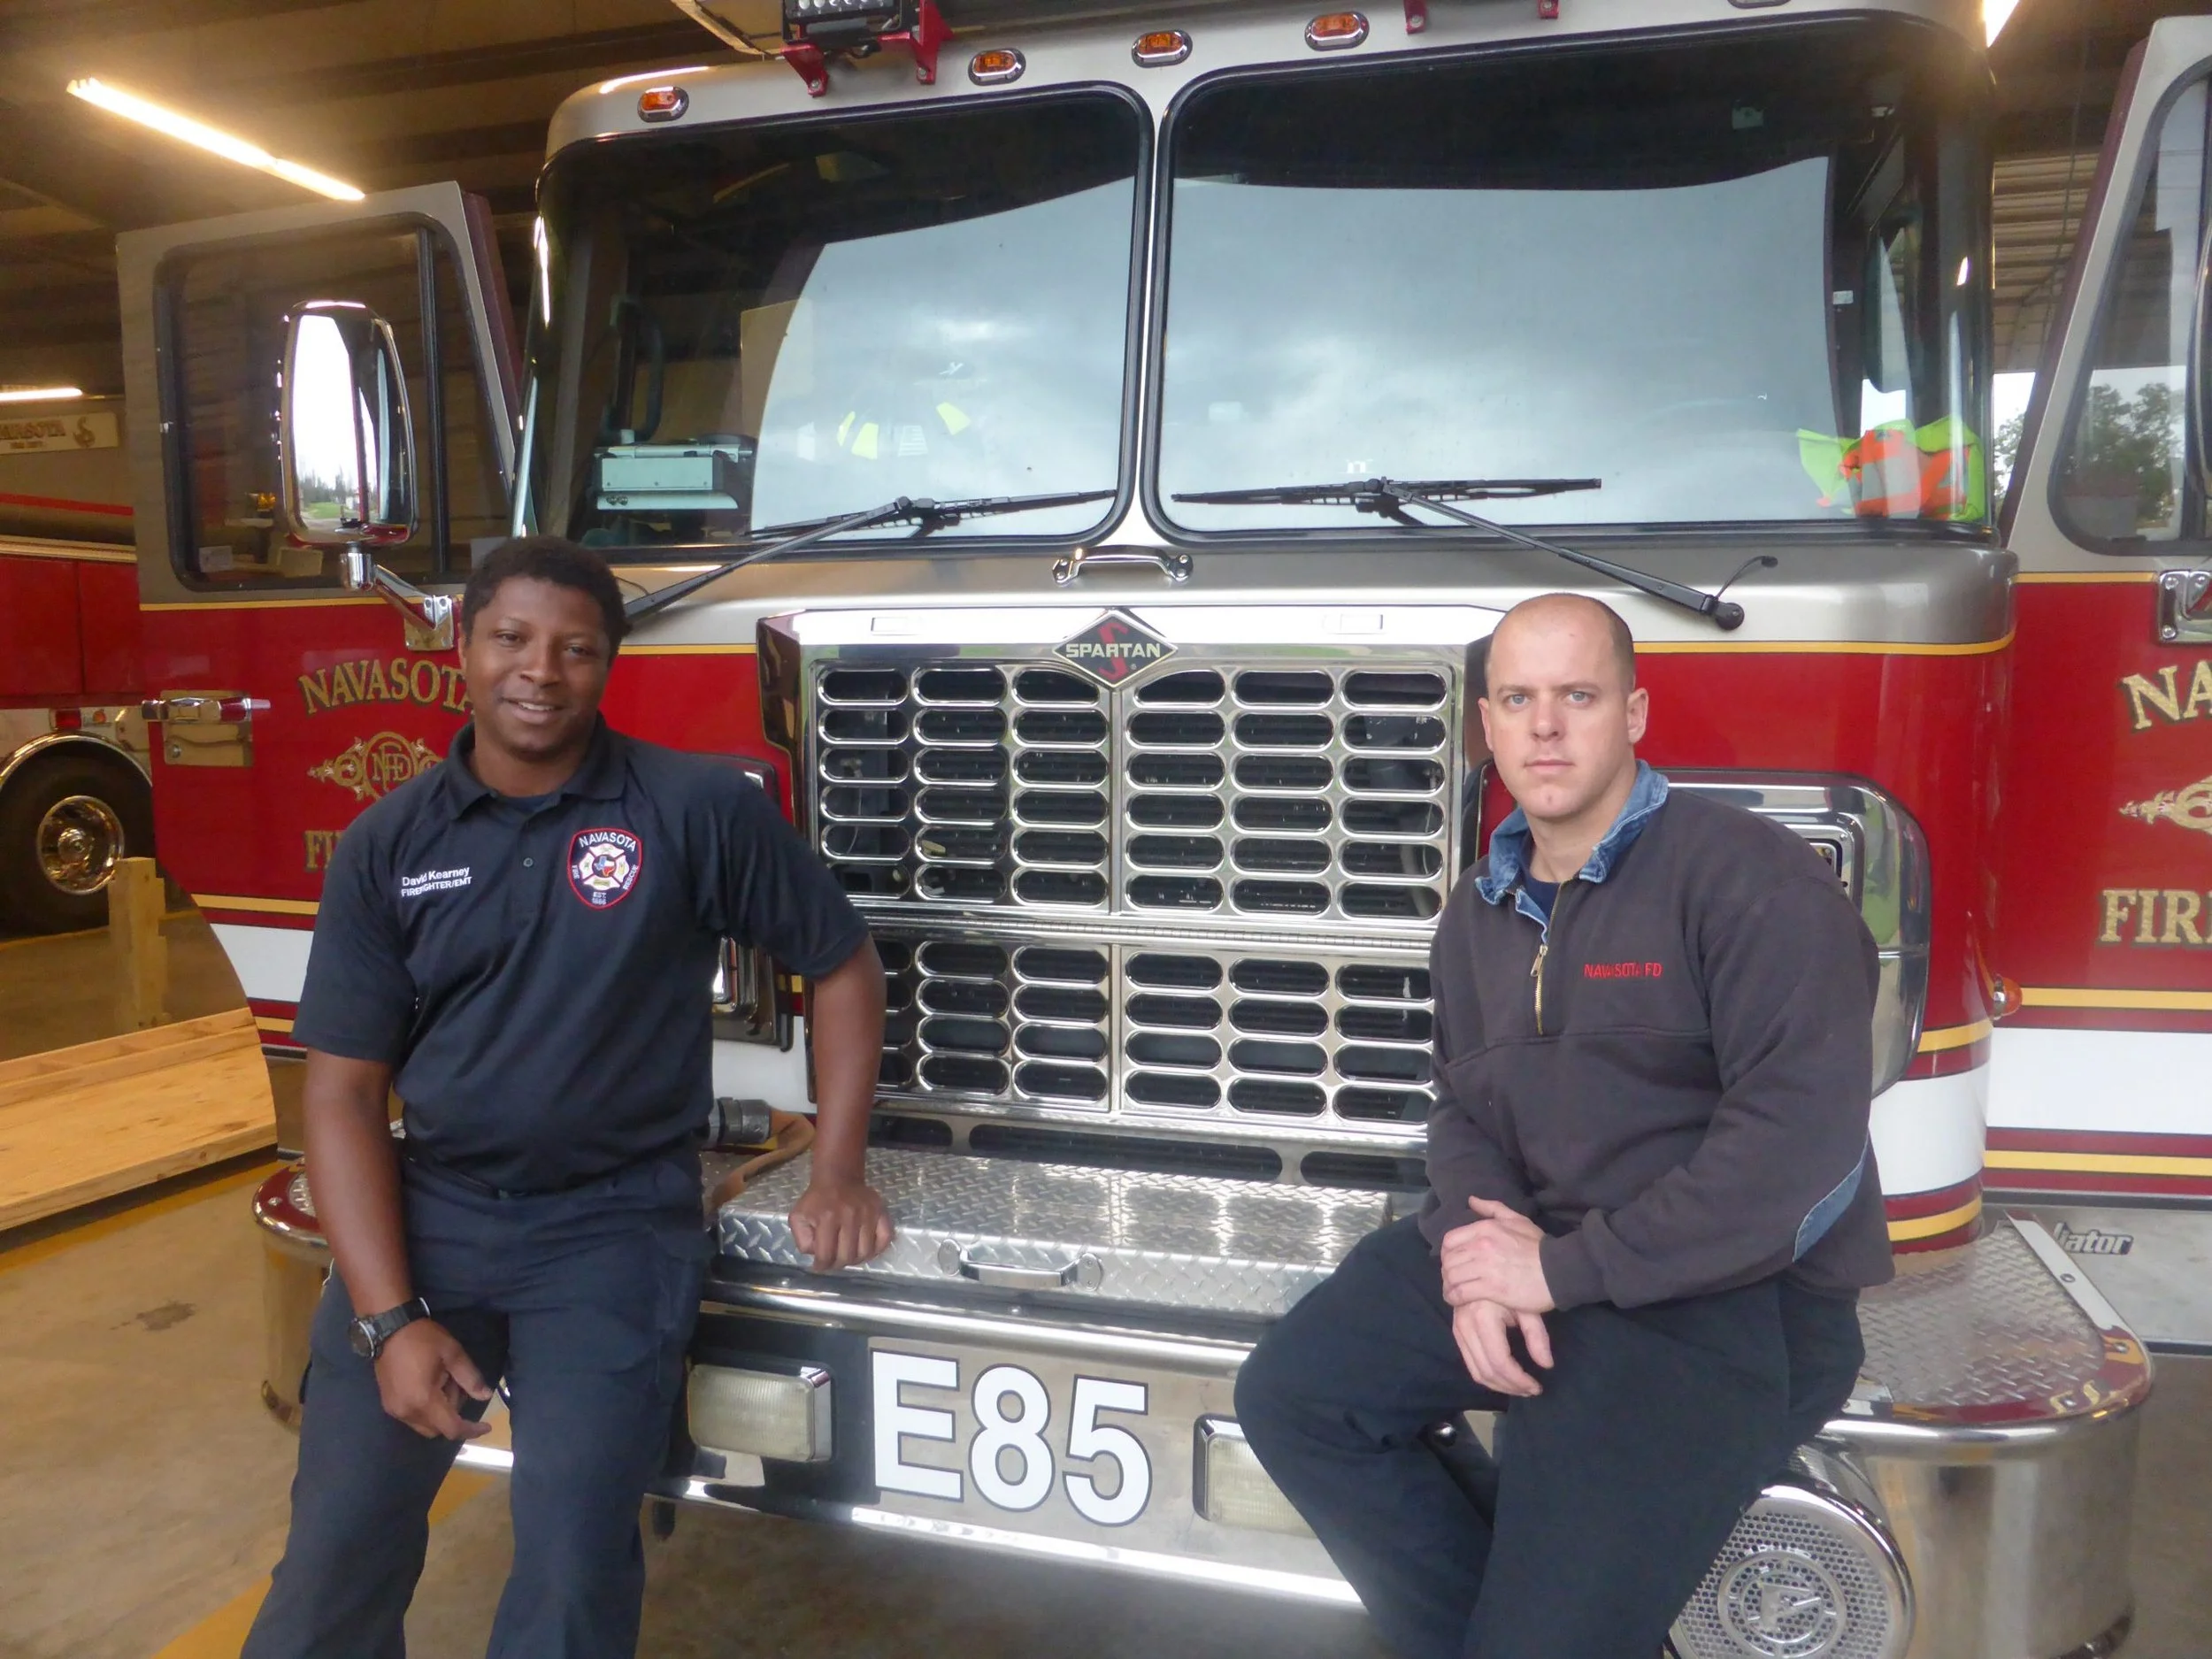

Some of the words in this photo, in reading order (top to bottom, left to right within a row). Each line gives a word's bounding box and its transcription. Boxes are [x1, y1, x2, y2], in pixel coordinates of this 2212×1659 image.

[1065, 642, 1161, 658] SPARTAN
[579, 832, 637, 852] NAVASOTA
[402, 872, 427, 887] David
[428, 866, 471, 881] Kearney
[623, 864, 638, 889] RESCUE
[2100, 888, 2212, 945] FIR
[1644, 962, 1663, 977] FD
[870, 1347, 1154, 1528] E85
